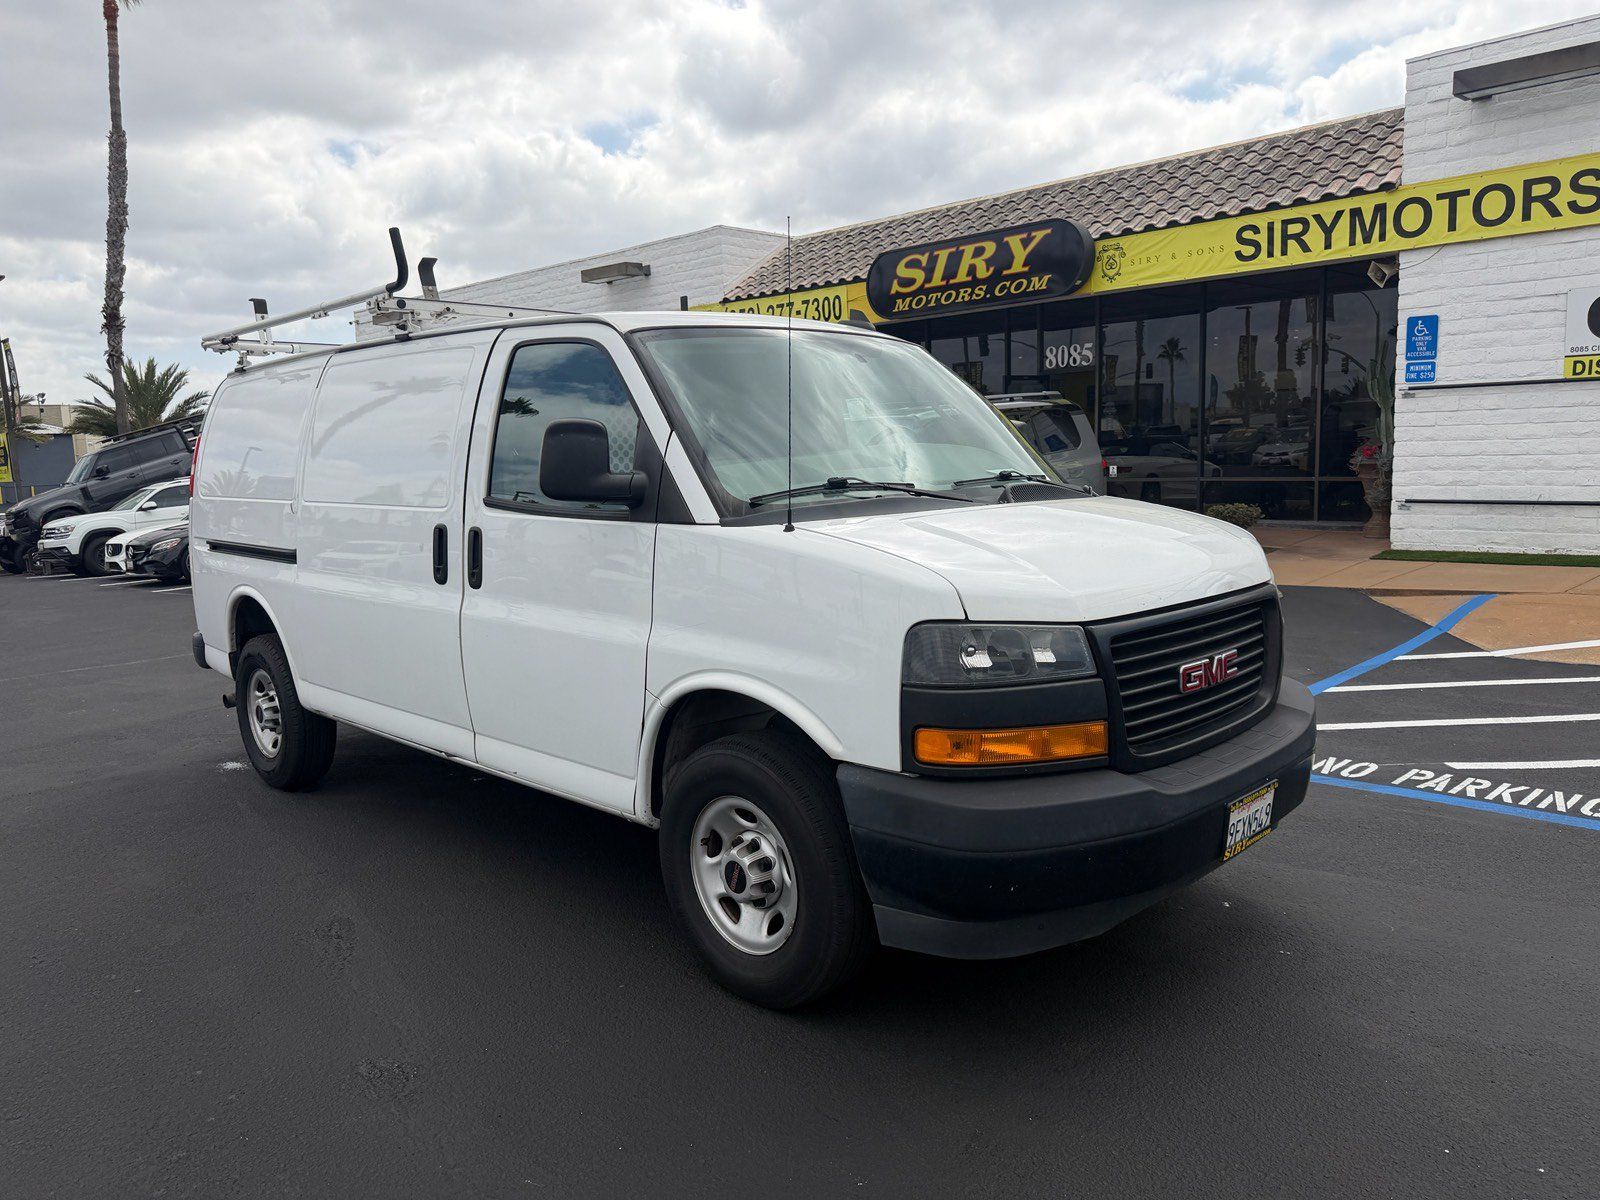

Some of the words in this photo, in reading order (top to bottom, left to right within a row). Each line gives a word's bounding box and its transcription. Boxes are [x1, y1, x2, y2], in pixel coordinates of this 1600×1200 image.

[890, 228, 1053, 295] SIRY
[1130, 255, 1161, 267] SIRY
[1187, 244, 1225, 258] SONS
[892, 274, 1052, 313] MOTORS.COM
[1045, 342, 1093, 369] 8085
[1570, 345, 1589, 353] 8085
[1179, 648, 1238, 694] GMC
[1312, 756, 1379, 778] NO
